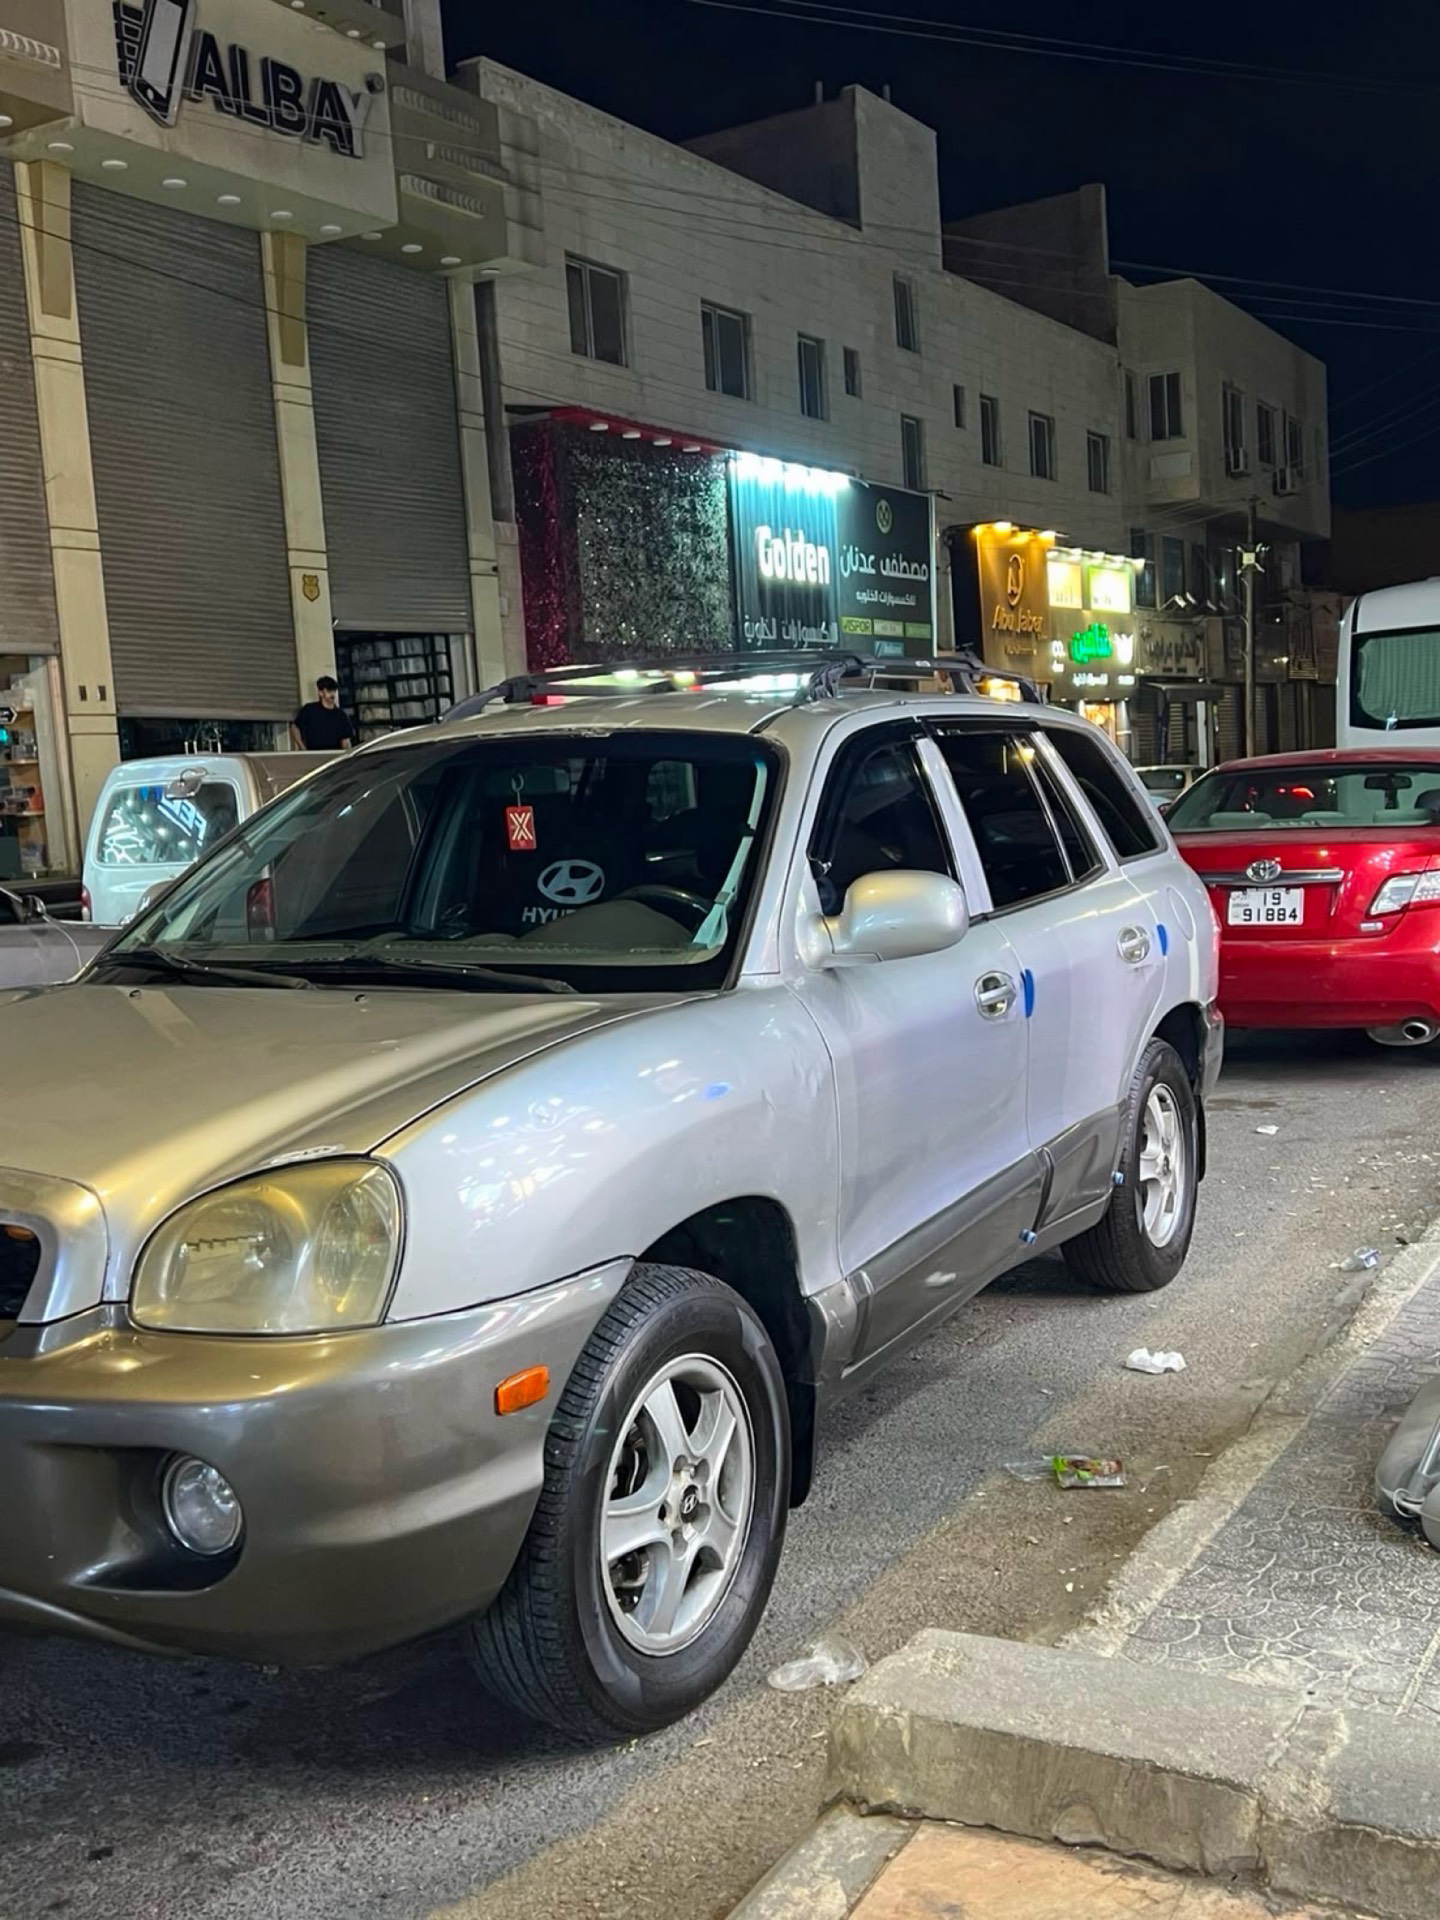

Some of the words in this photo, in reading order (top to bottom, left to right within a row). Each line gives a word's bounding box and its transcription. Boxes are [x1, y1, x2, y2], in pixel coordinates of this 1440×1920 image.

[184, 29, 371, 158] ALBAY
[755, 525, 830, 584] Golden
[840, 544, 876, 578] عدنان
[1242, 907, 1298, 922] 91884
[1263, 892, 1282, 907] 19
